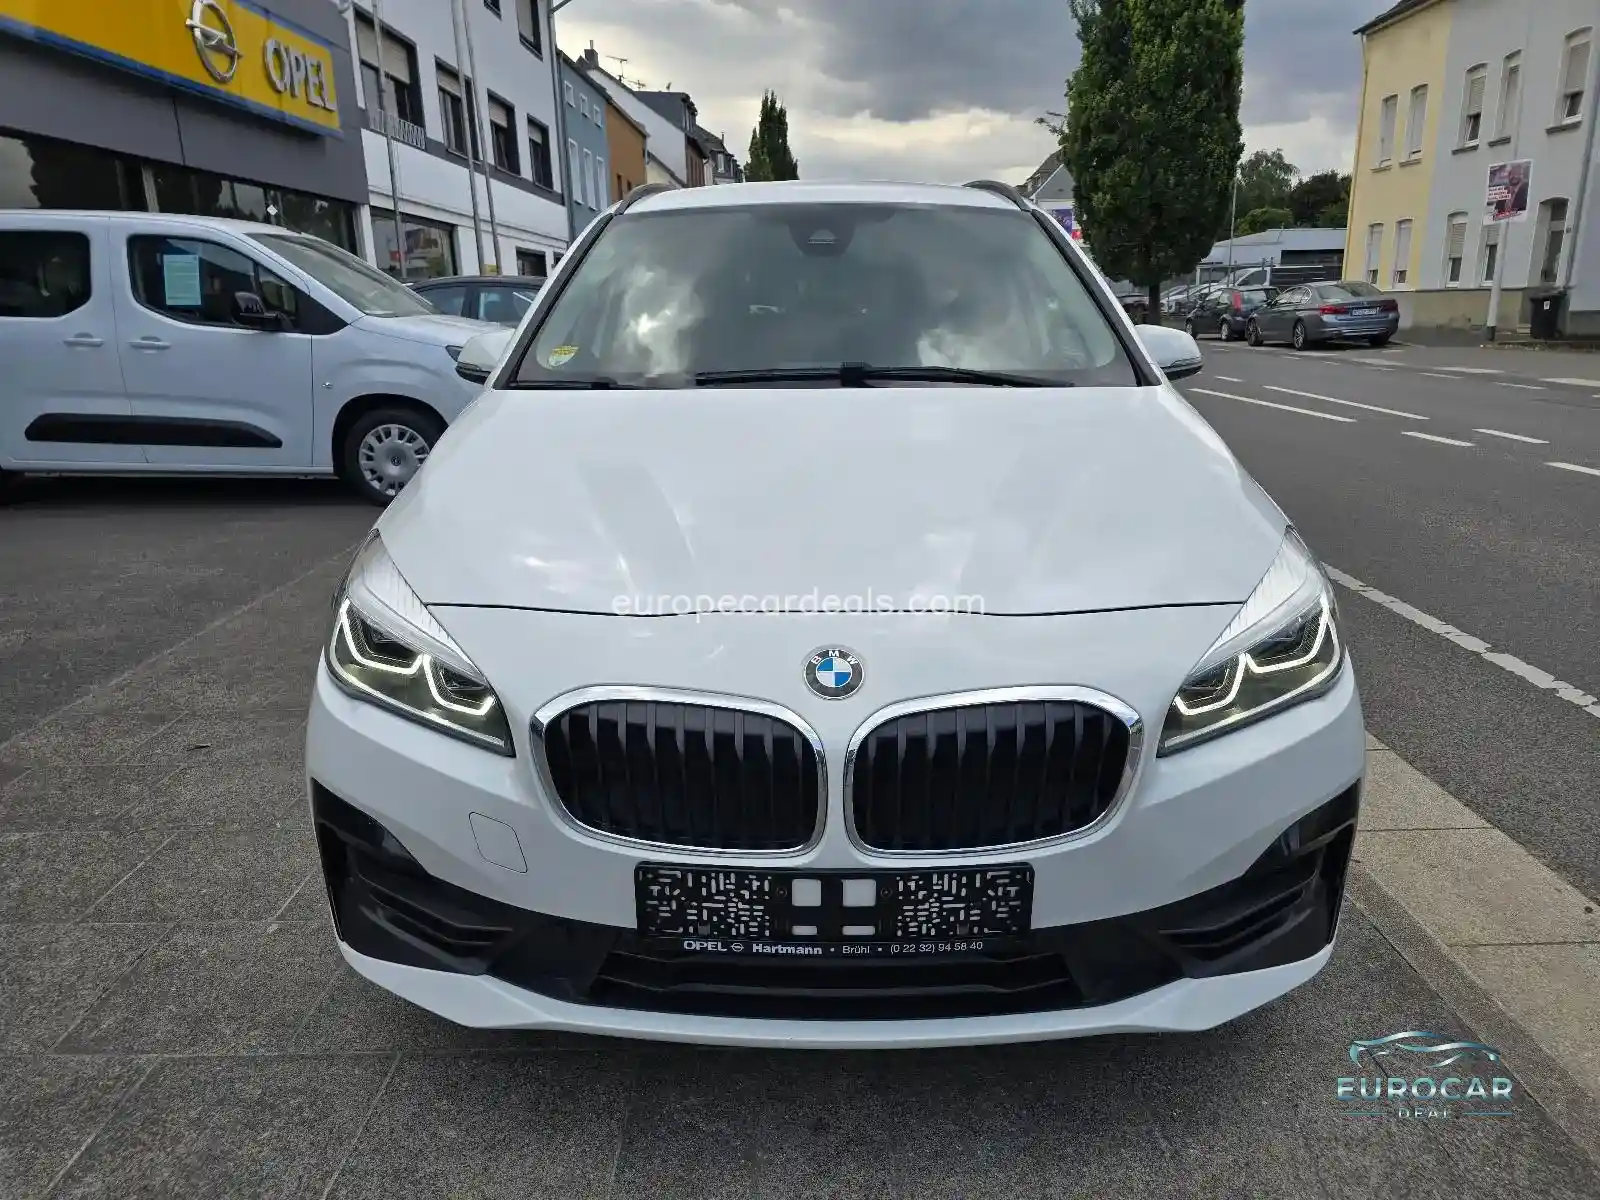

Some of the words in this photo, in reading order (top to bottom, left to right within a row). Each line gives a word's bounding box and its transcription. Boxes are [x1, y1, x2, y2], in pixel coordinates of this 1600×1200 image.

[264, 39, 337, 111] OPEL
[683, 940, 727, 952] OPEL
[752, 943, 823, 955] Hartmann
[842, 945, 870, 954] Brühl
[902, 944, 916, 953] 22
[918, 943, 935, 954] 32)
[938, 943, 951, 952] 94
[954, 942, 967, 951] 58
[970, 941, 983, 950] 40
